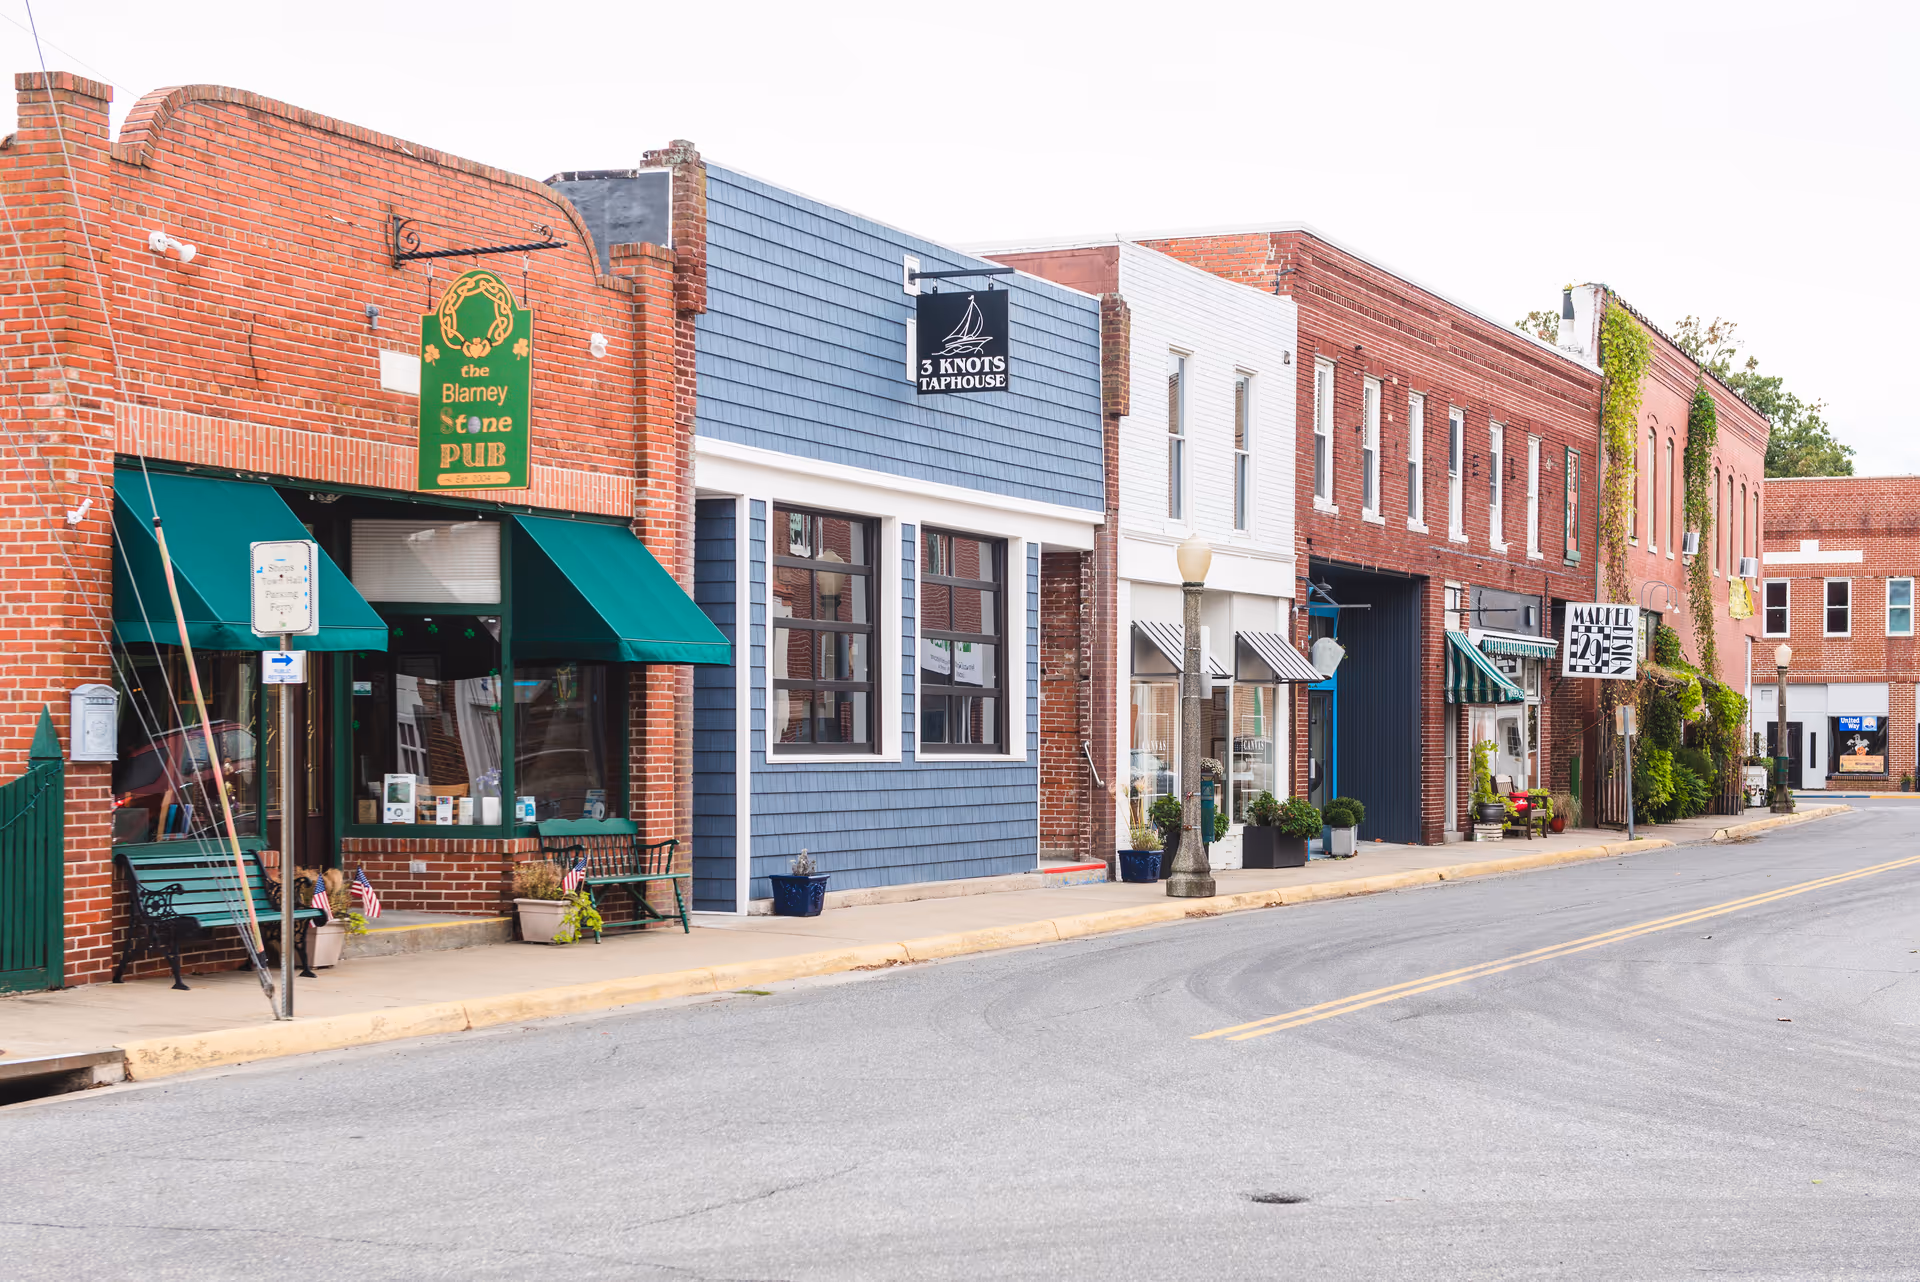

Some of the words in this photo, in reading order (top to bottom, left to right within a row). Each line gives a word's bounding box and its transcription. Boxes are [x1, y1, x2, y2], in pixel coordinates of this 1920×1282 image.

[461, 364, 490, 378] the
[921, 359, 933, 375] 3
[940, 356, 1006, 374] KNOTS
[919, 374, 1007, 390] TAPHOUSE
[442, 383, 508, 406] Blarney
[439, 407, 512, 434] Stone
[440, 442, 506, 468] PUB
[268, 564, 295, 574] Shops
[286, 576, 303, 584] Hall
[265, 590, 299, 600] Parking
[1572, 606, 1634, 626] MARKER
[1578, 634, 1602, 666] 29
[1610, 627, 1633, 675] DESIGN
